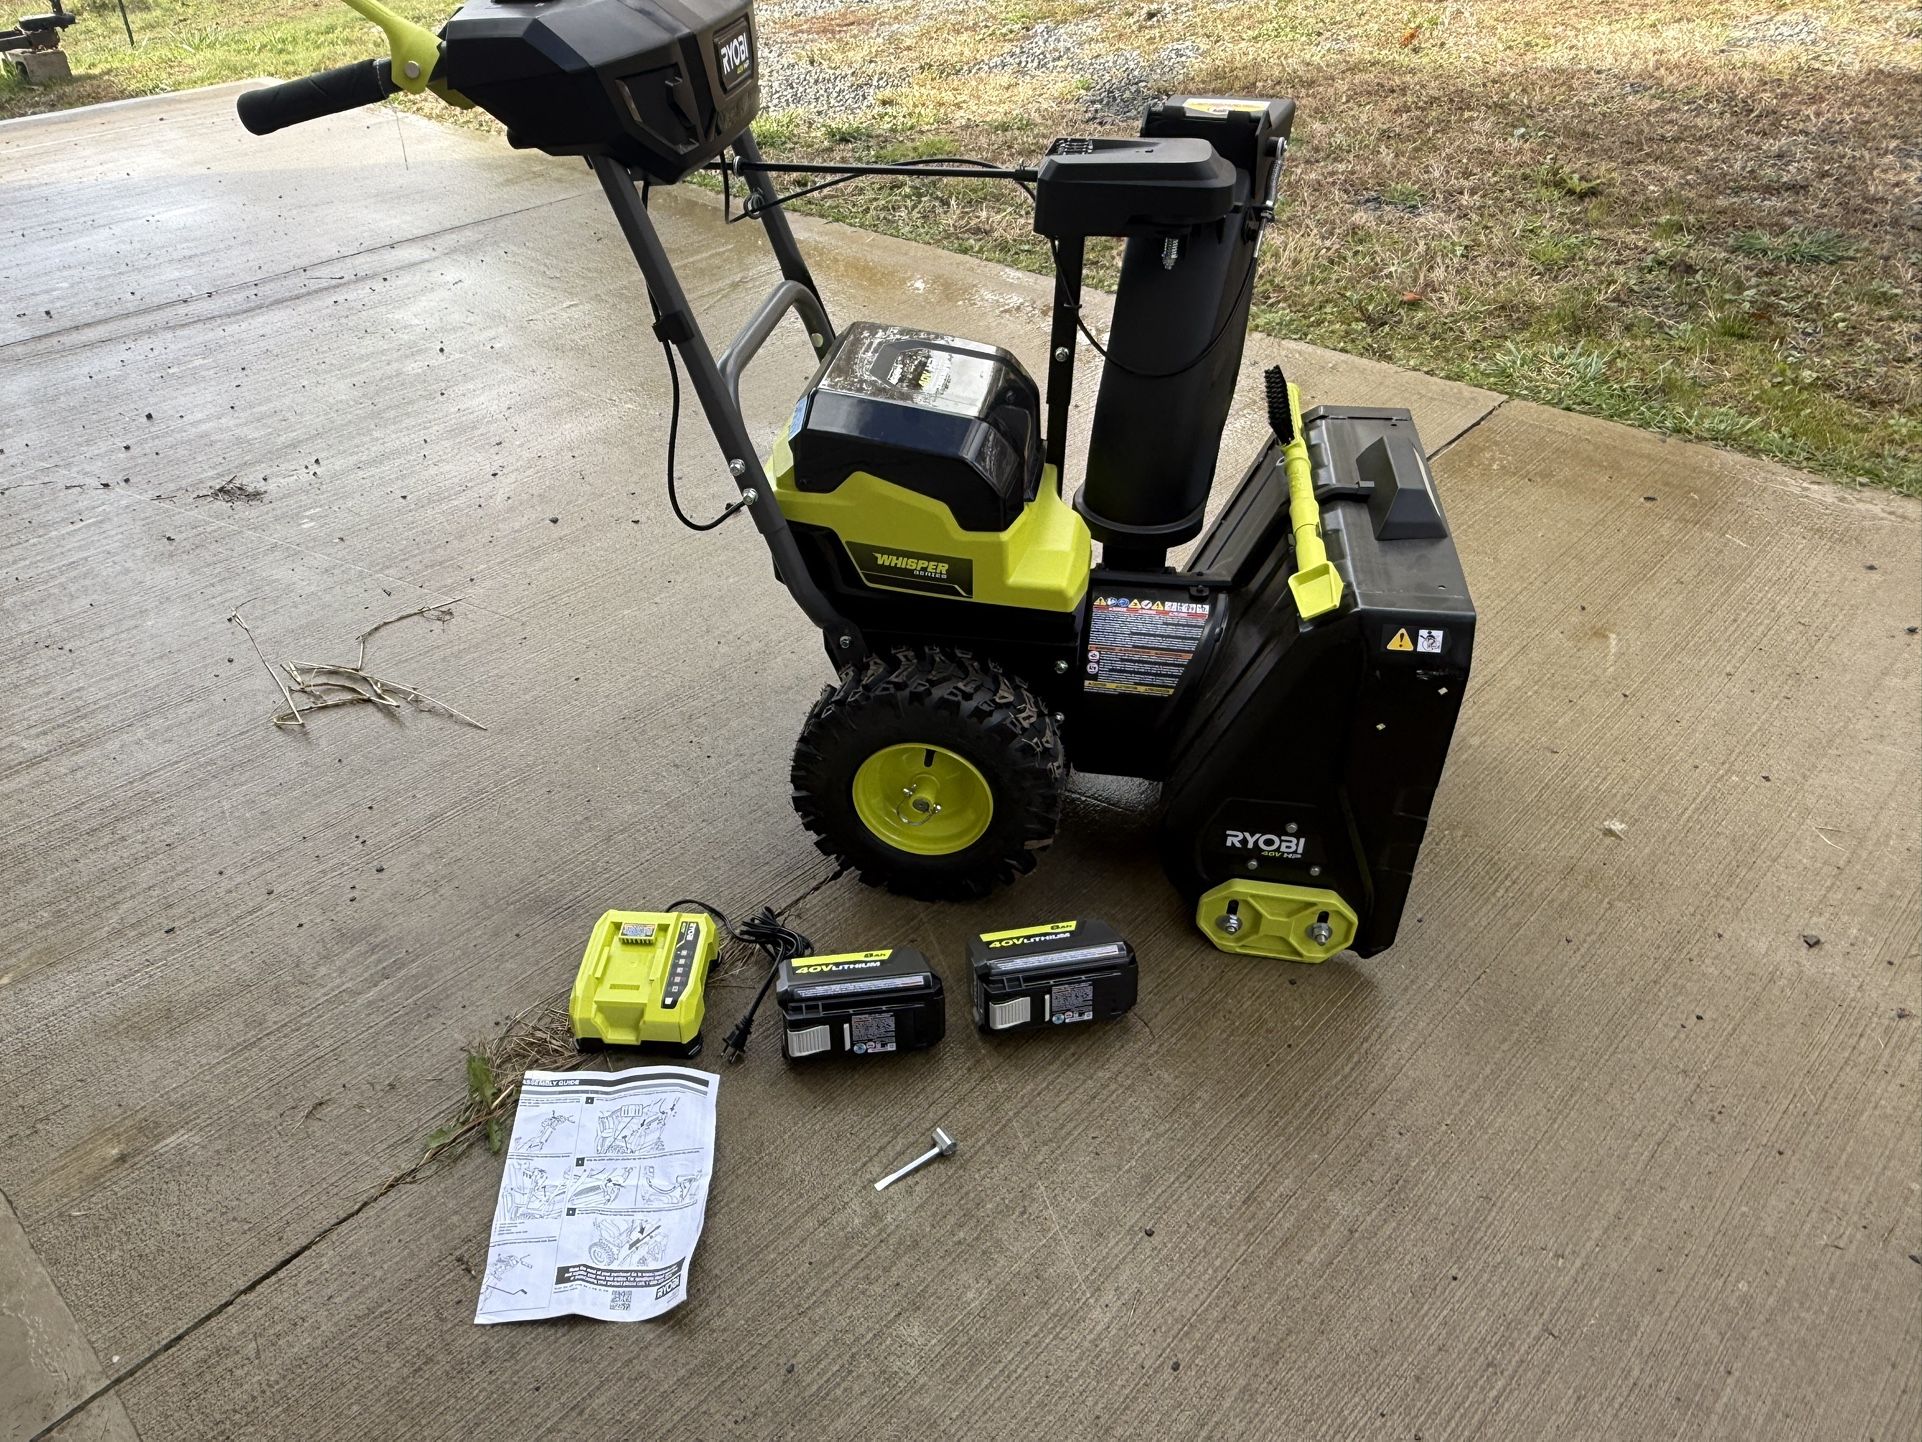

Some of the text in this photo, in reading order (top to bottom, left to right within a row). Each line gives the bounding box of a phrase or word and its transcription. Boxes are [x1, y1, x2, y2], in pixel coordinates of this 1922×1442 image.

[721, 32, 748, 75] RYOBI
[872, 552, 949, 574] WHISPER
[1226, 830, 1305, 854] RYOBI
